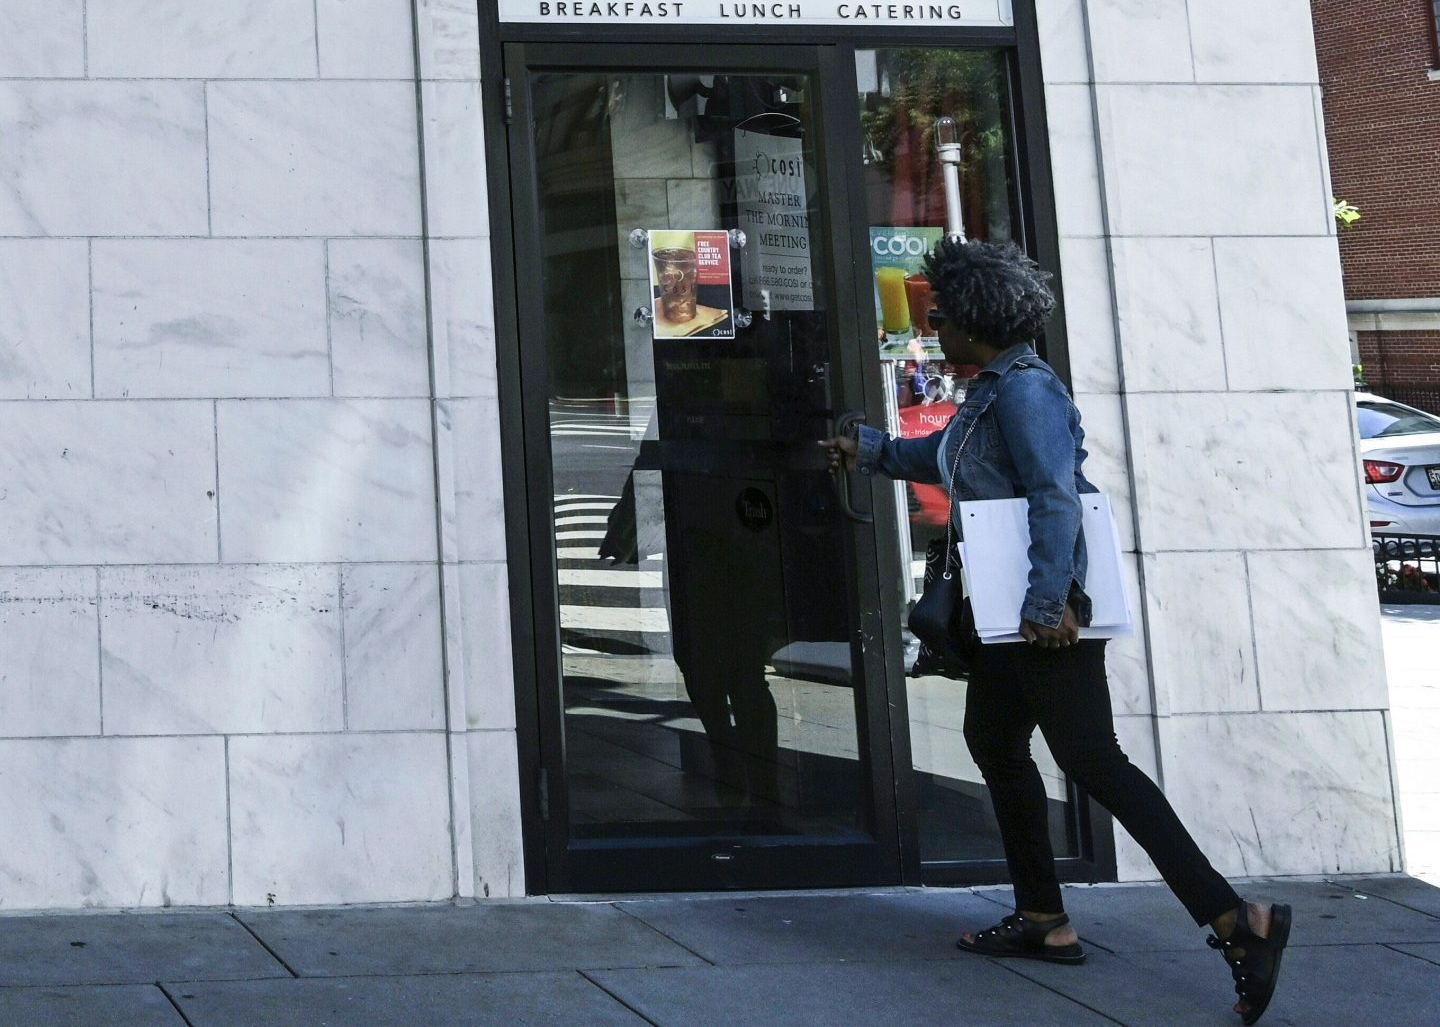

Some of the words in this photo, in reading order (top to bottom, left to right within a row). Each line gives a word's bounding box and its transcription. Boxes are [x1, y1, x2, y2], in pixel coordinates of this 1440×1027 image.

[539, 1, 685, 18] BREAKFAST
[719, 3, 802, 19] LUNCH
[837, 4, 962, 21] CATERING
[758, 191, 801, 207] MASTER
[746, 210, 763, 224] THE
[760, 234, 807, 249] MEETING
[779, 265, 787, 274] to
[788, 266, 808, 275] order?
